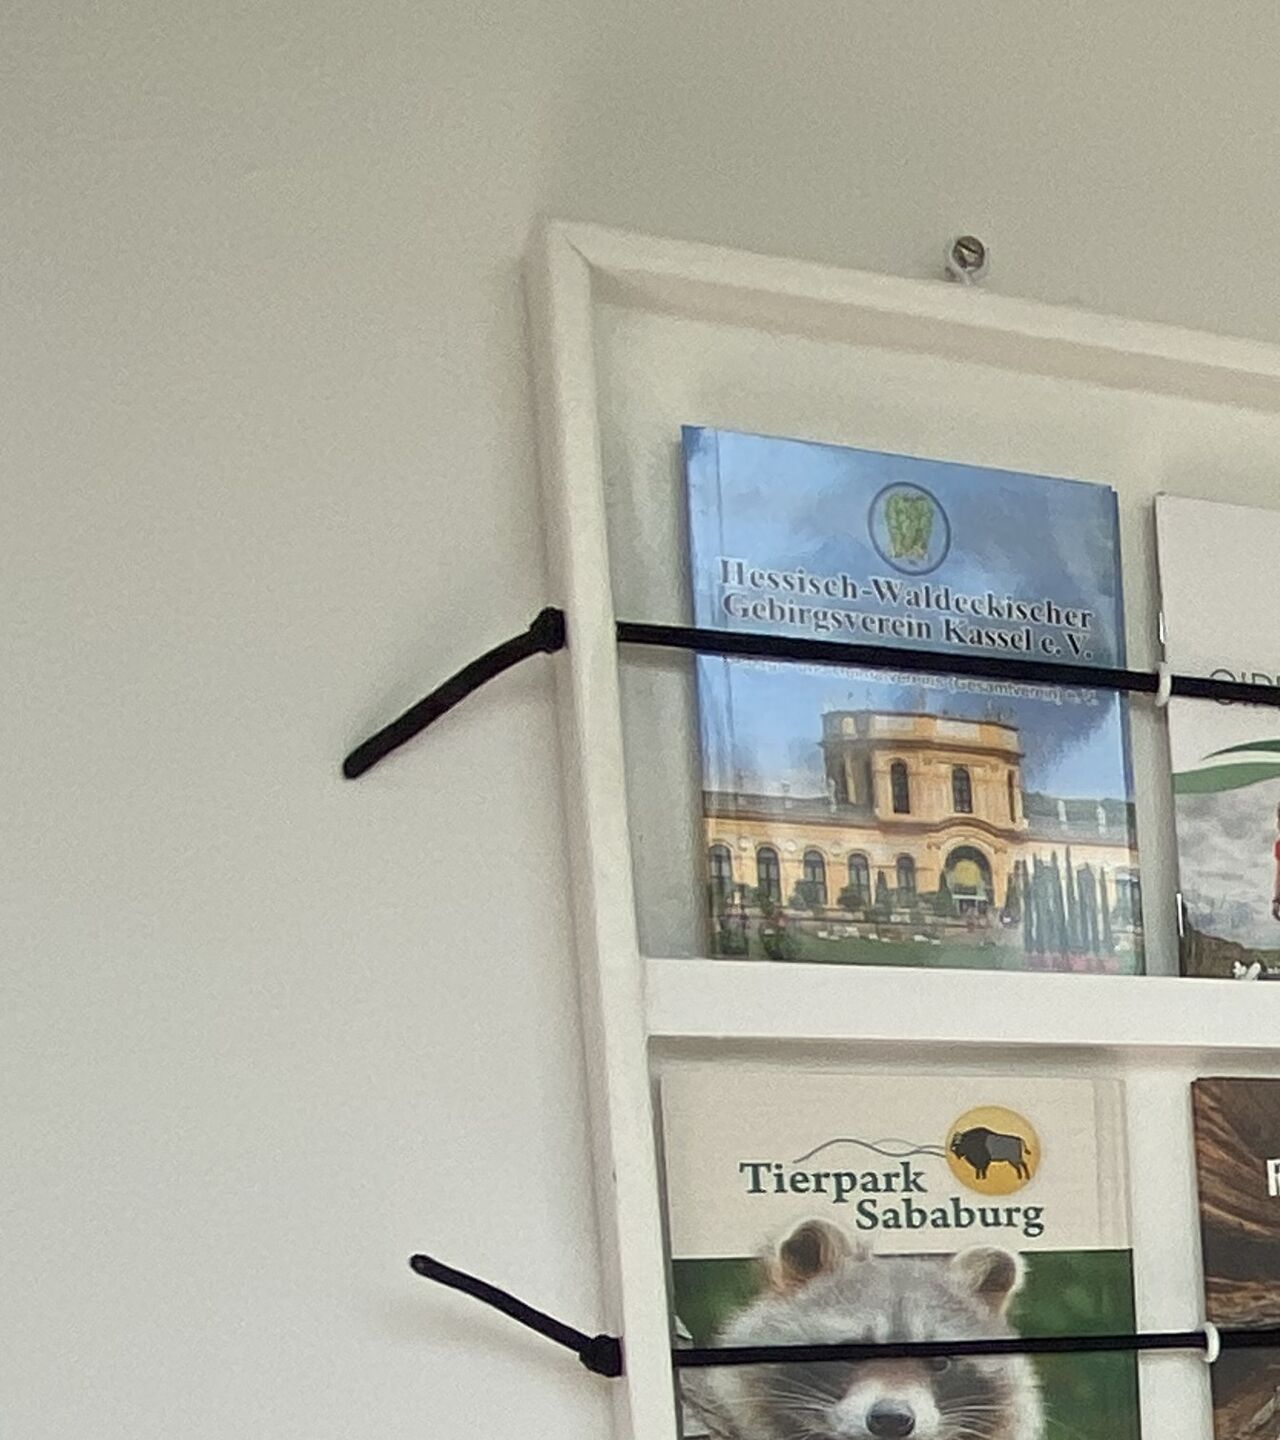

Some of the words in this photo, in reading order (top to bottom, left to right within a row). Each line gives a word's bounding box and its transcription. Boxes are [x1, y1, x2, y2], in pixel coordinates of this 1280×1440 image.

[719, 559, 1093, 630] Hessisch-Waldeckischer
[722, 593, 932, 641] Gebirgsverein
[942, 619, 1031, 652] Kassel
[738, 1161, 929, 1203] Tierpark
[854, 1197, 1047, 1239] Sababurg
